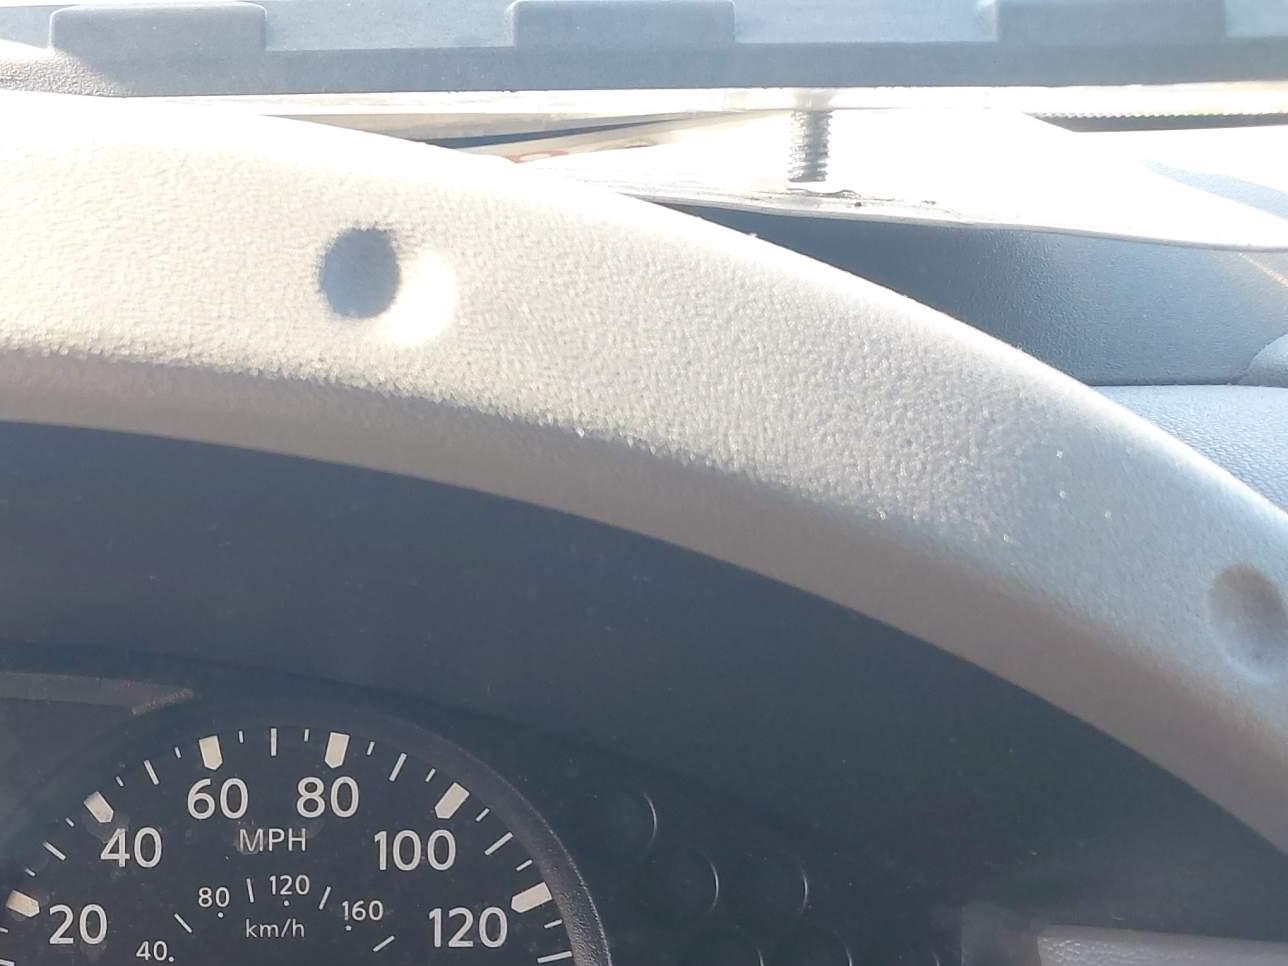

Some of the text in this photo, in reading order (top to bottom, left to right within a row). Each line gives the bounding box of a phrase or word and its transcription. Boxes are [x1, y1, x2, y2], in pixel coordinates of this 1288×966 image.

[187, 777, 249, 819] 60
[296, 776, 359, 818] 80
[100, 827, 162, 868] 40
[239, 828, 306, 852] MPH
[374, 829, 456, 871] 100
[198, 886, 230, 908] 80
[269, 874, 310, 895] 120
[49, 903, 108, 945] 20
[342, 900, 384, 921] 160
[245, 918, 305, 938] km/h
[428, 906, 508, 948] 120
[136, 940, 167, 961] 40
